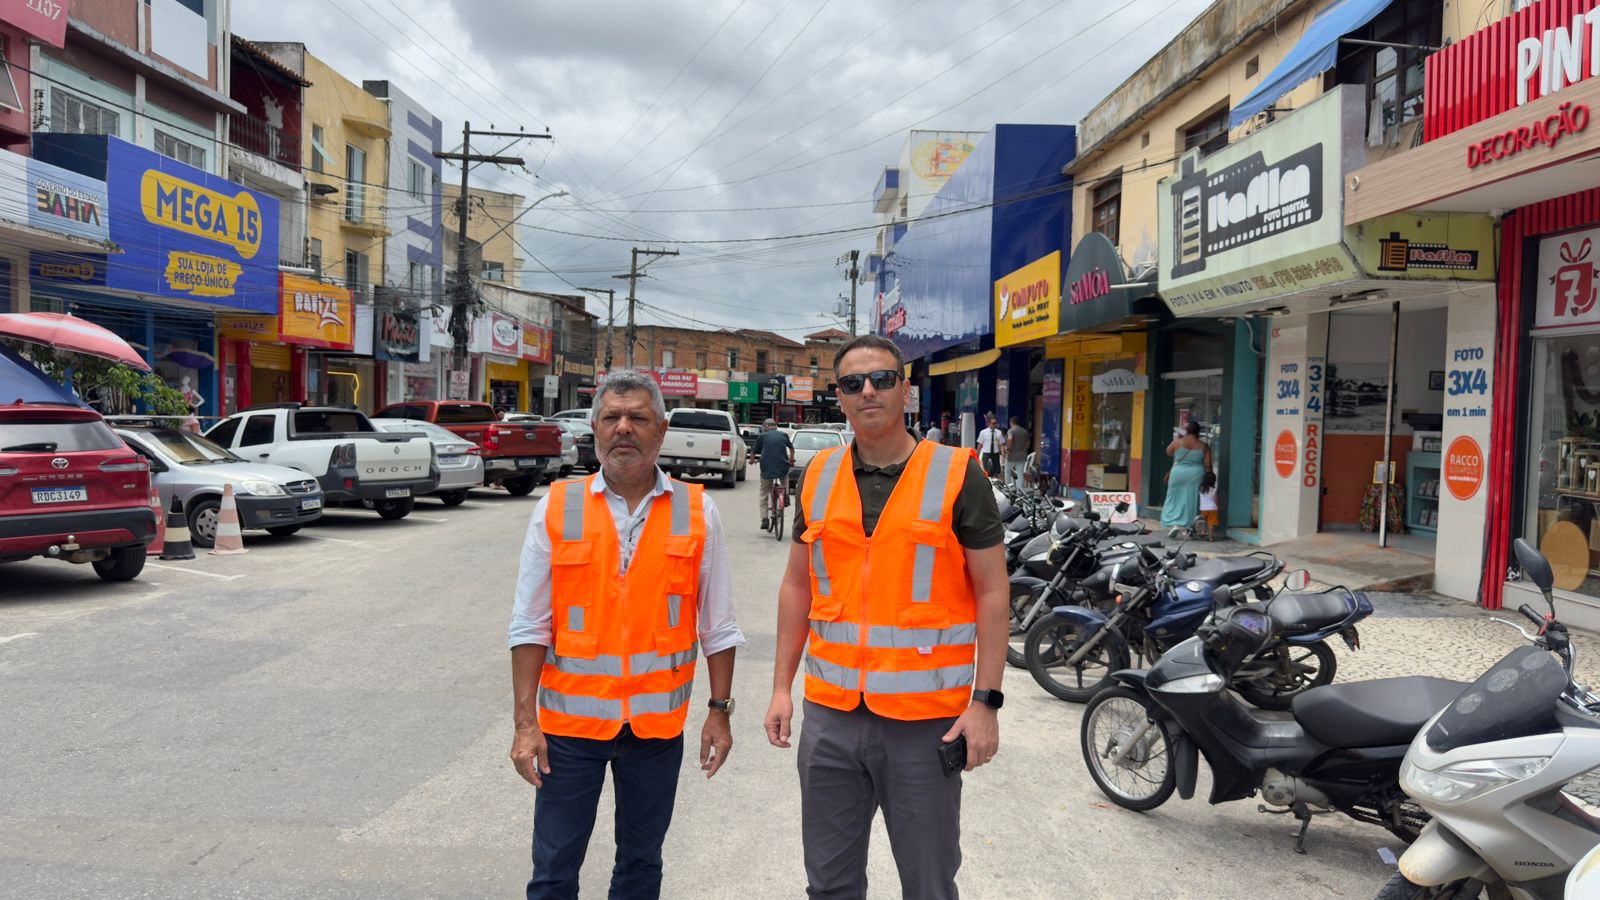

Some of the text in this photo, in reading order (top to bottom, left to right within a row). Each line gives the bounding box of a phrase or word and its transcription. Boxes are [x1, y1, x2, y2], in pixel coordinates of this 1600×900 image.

[1467, 101, 1590, 168] DECORAÇÃO
[36, 179, 68, 195] GOVERNO
[68, 187, 77, 197] DO
[36, 188, 100, 226] BAHIA
[1207, 164, 1310, 233] Itafilm
[156, 180, 259, 245] MEGA 15
[1263, 198, 1309, 223] FOTO DIGITAL
[1410, 248, 1472, 263] Itafilm
[79, 266, 91, 277] 15
[178, 257, 227, 275] SUA LOJA DE
[174, 271, 202, 287] PREÇO
[1170, 295, 1188, 307] FOTO
[1203, 288, 1218, 300] EM
[1221, 280, 1254, 297] MINUTO
[1454, 347, 1484, 362] FOTO
[1280, 363, 1298, 374] FOTO
[1276, 379, 1300, 400] 3X4
[1447, 368, 1488, 396] 3X4
[1075, 384, 1086, 422] FOTO
[1446, 405, 1487, 417] em 1 min
[1303, 424, 1319, 488] RACCO
[1450, 454, 1479, 467] RACCO
[365, 465, 422, 474] OROCH
[36, 490, 81, 502] RDC3149
[1092, 494, 1132, 504] RACCO
[1514, 860, 1556, 868] HONDA
